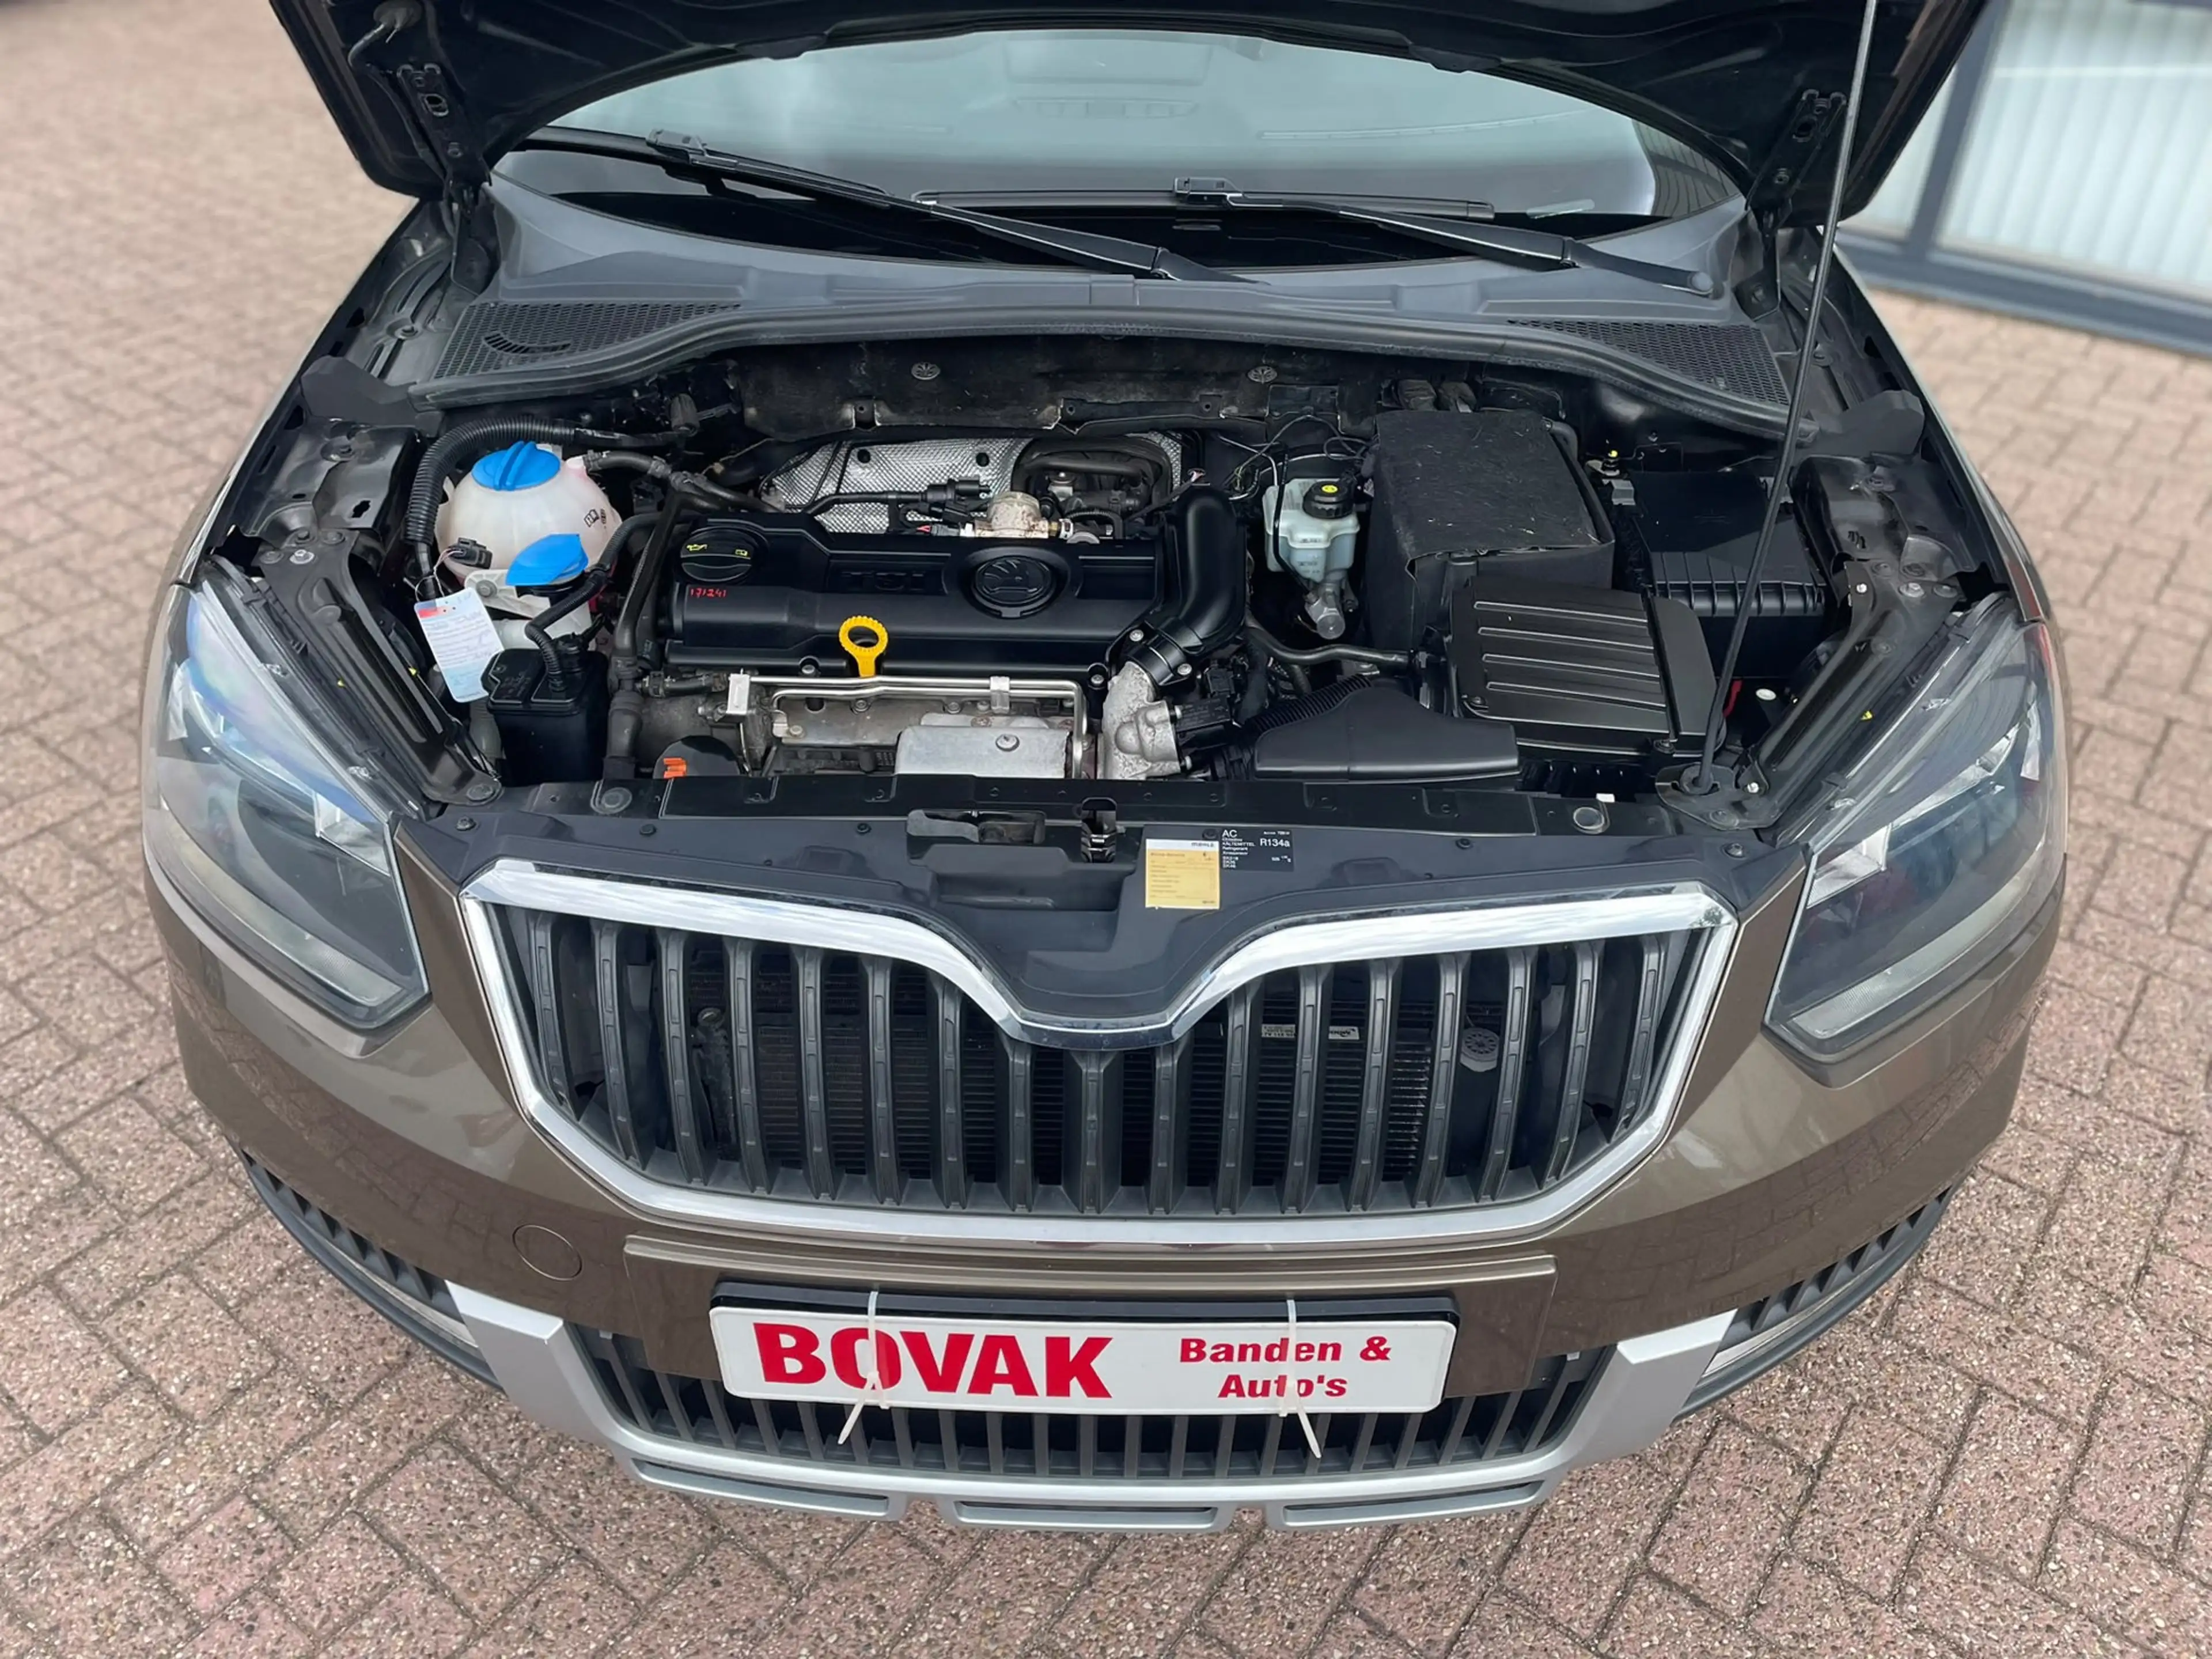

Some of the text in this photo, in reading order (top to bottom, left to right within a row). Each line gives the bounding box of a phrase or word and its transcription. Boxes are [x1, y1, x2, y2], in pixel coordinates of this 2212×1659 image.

[1222, 830, 1237, 838] AC
[1260, 838, 1290, 847] R134a
[752, 1322, 1112, 1399] BOVAK
[1180, 1336, 1391, 1363] Banden &
[1218, 1374, 1347, 1398] Auto's
